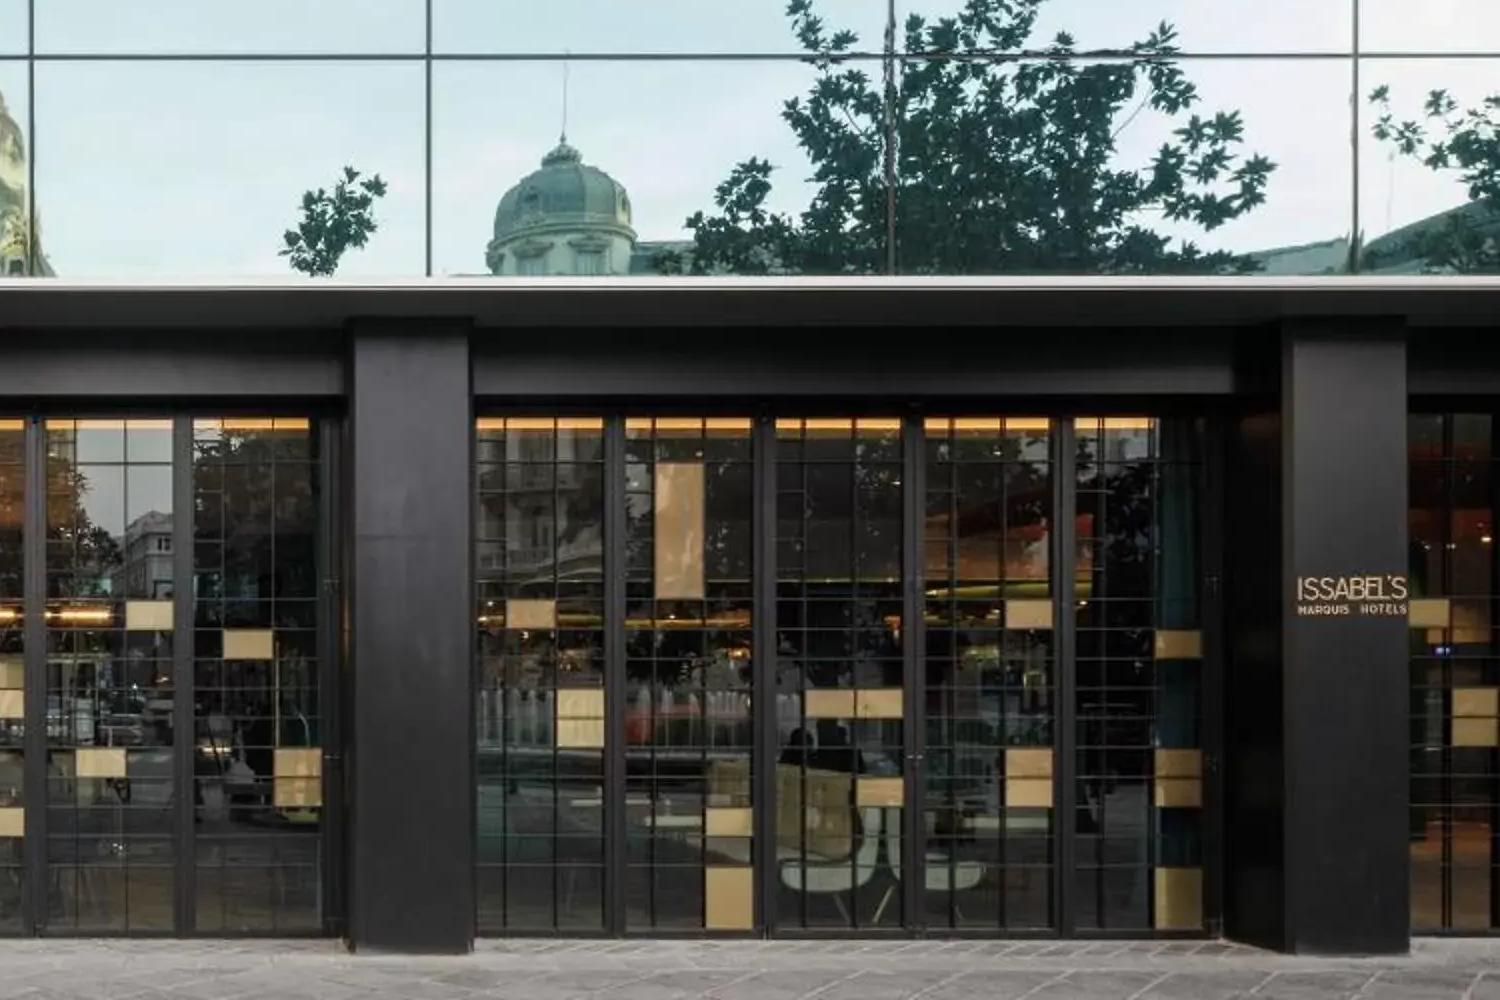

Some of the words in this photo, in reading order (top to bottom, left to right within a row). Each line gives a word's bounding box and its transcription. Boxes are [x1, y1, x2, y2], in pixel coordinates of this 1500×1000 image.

[1297, 575, 1408, 601] ISSABEL'S
[1298, 603, 1349, 615] MARQUIS
[1360, 603, 1407, 615] HOTELS
